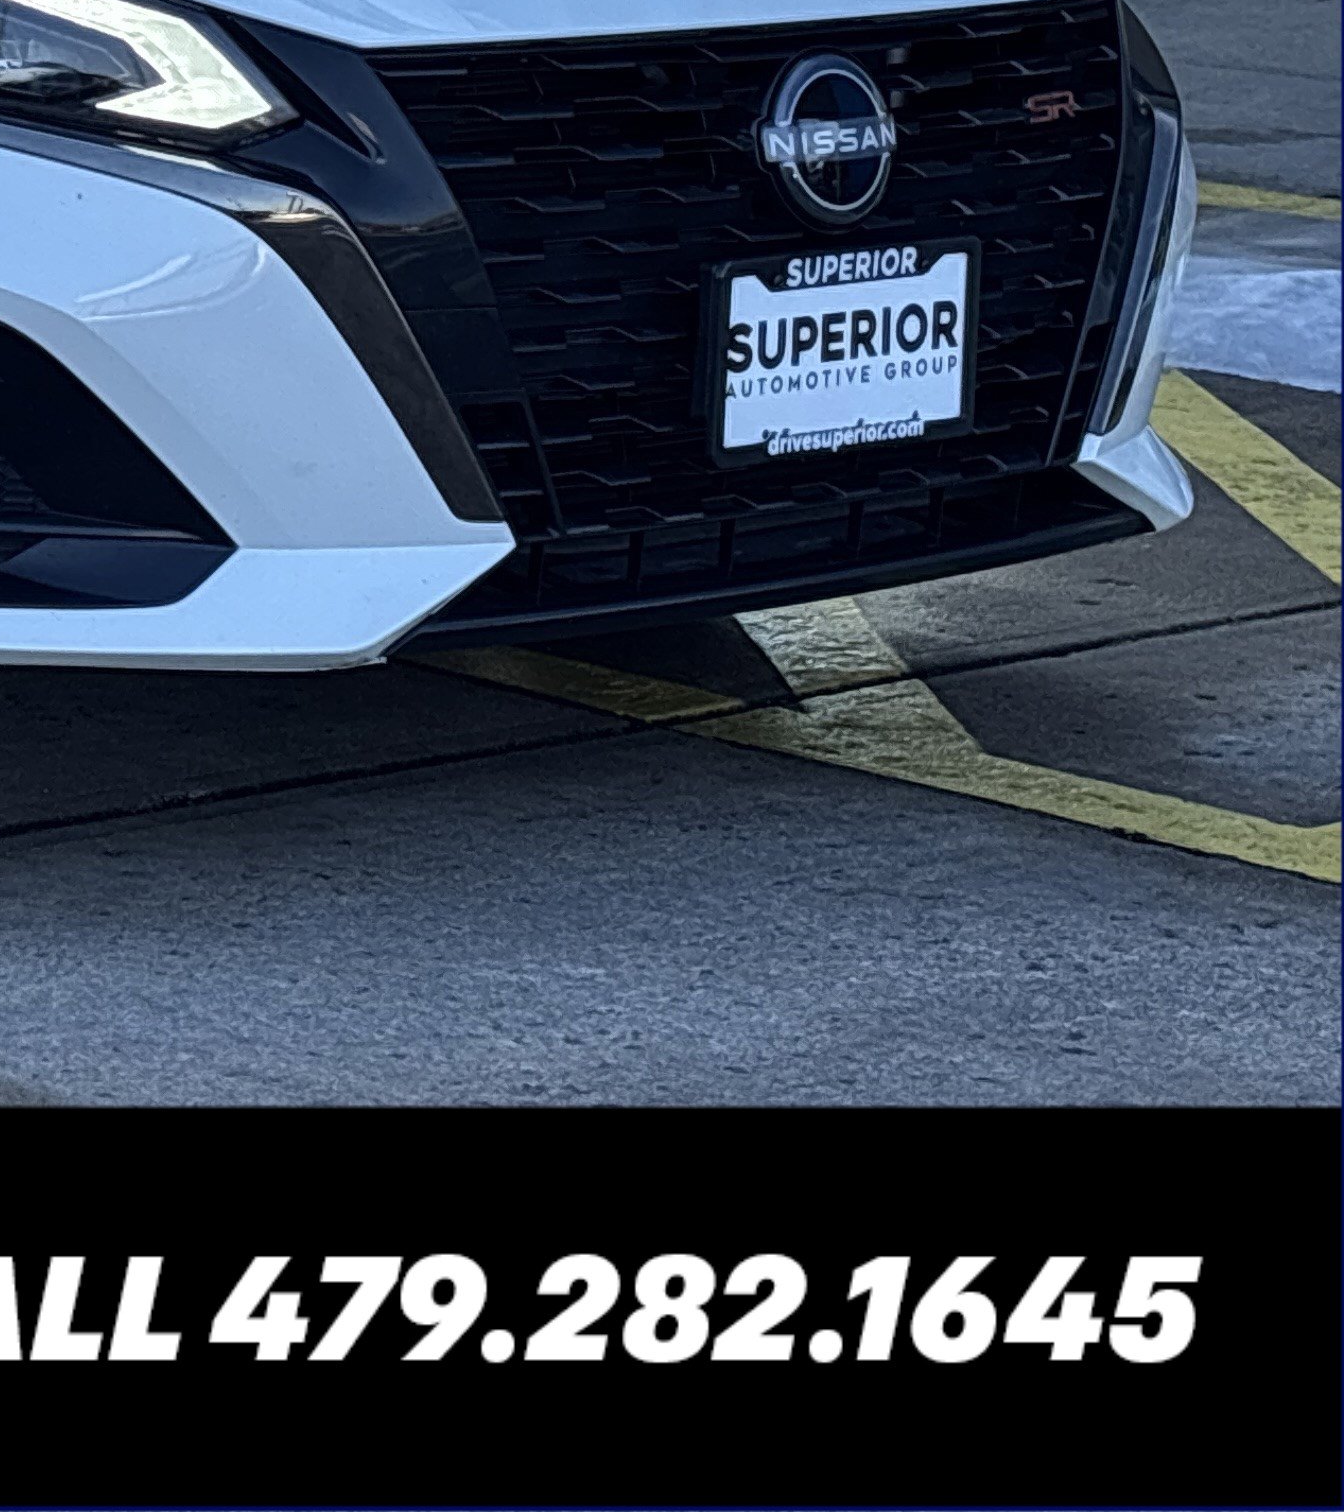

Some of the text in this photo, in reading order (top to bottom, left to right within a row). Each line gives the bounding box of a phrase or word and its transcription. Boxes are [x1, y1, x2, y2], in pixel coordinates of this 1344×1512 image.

[1029, 91, 1076, 124] SR
[768, 121, 896, 158] NISSAN
[785, 246, 918, 288] SUPERIOR
[725, 300, 959, 374] SUPERIOR
[725, 354, 959, 400] AUTOMOTIVE GROUP
[767, 418, 926, 456] drivesuperior.com
